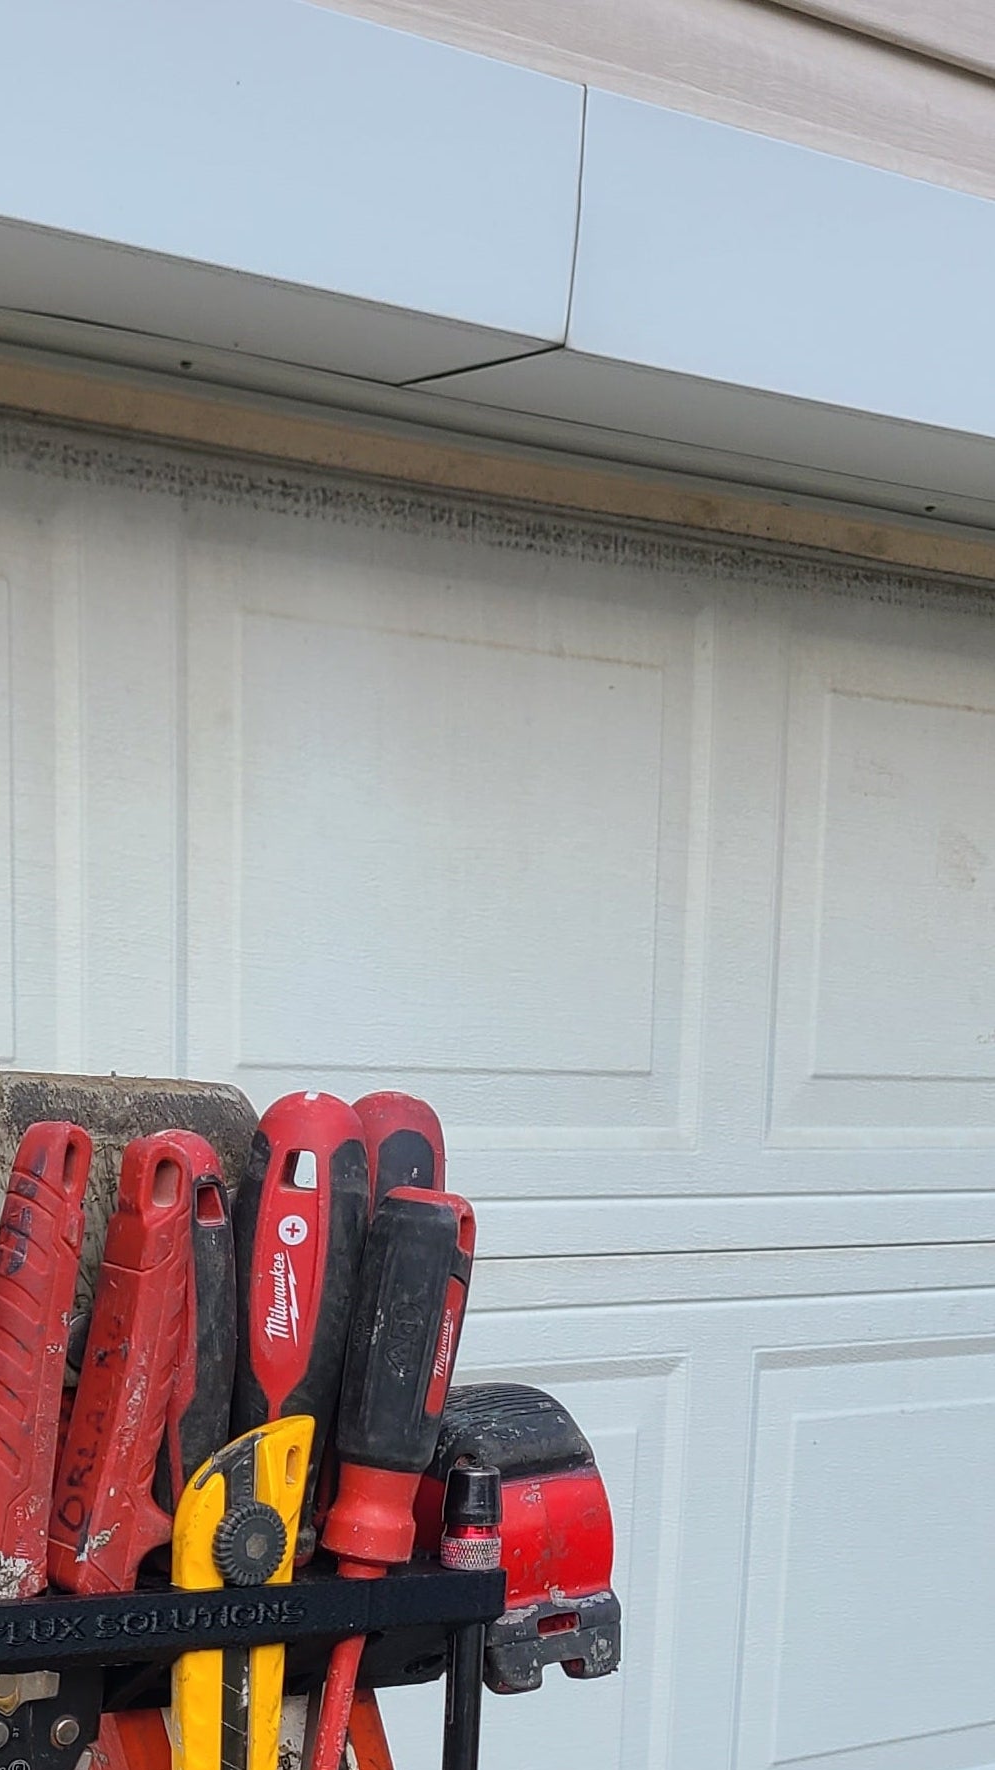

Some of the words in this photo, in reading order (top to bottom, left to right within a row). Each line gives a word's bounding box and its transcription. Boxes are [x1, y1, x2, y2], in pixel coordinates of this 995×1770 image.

[264, 1252, 290, 1342] Milwaukee
[433, 1309, 454, 1378] Milwaukee
[95, 1600, 305, 1639] SOLUTIONS
